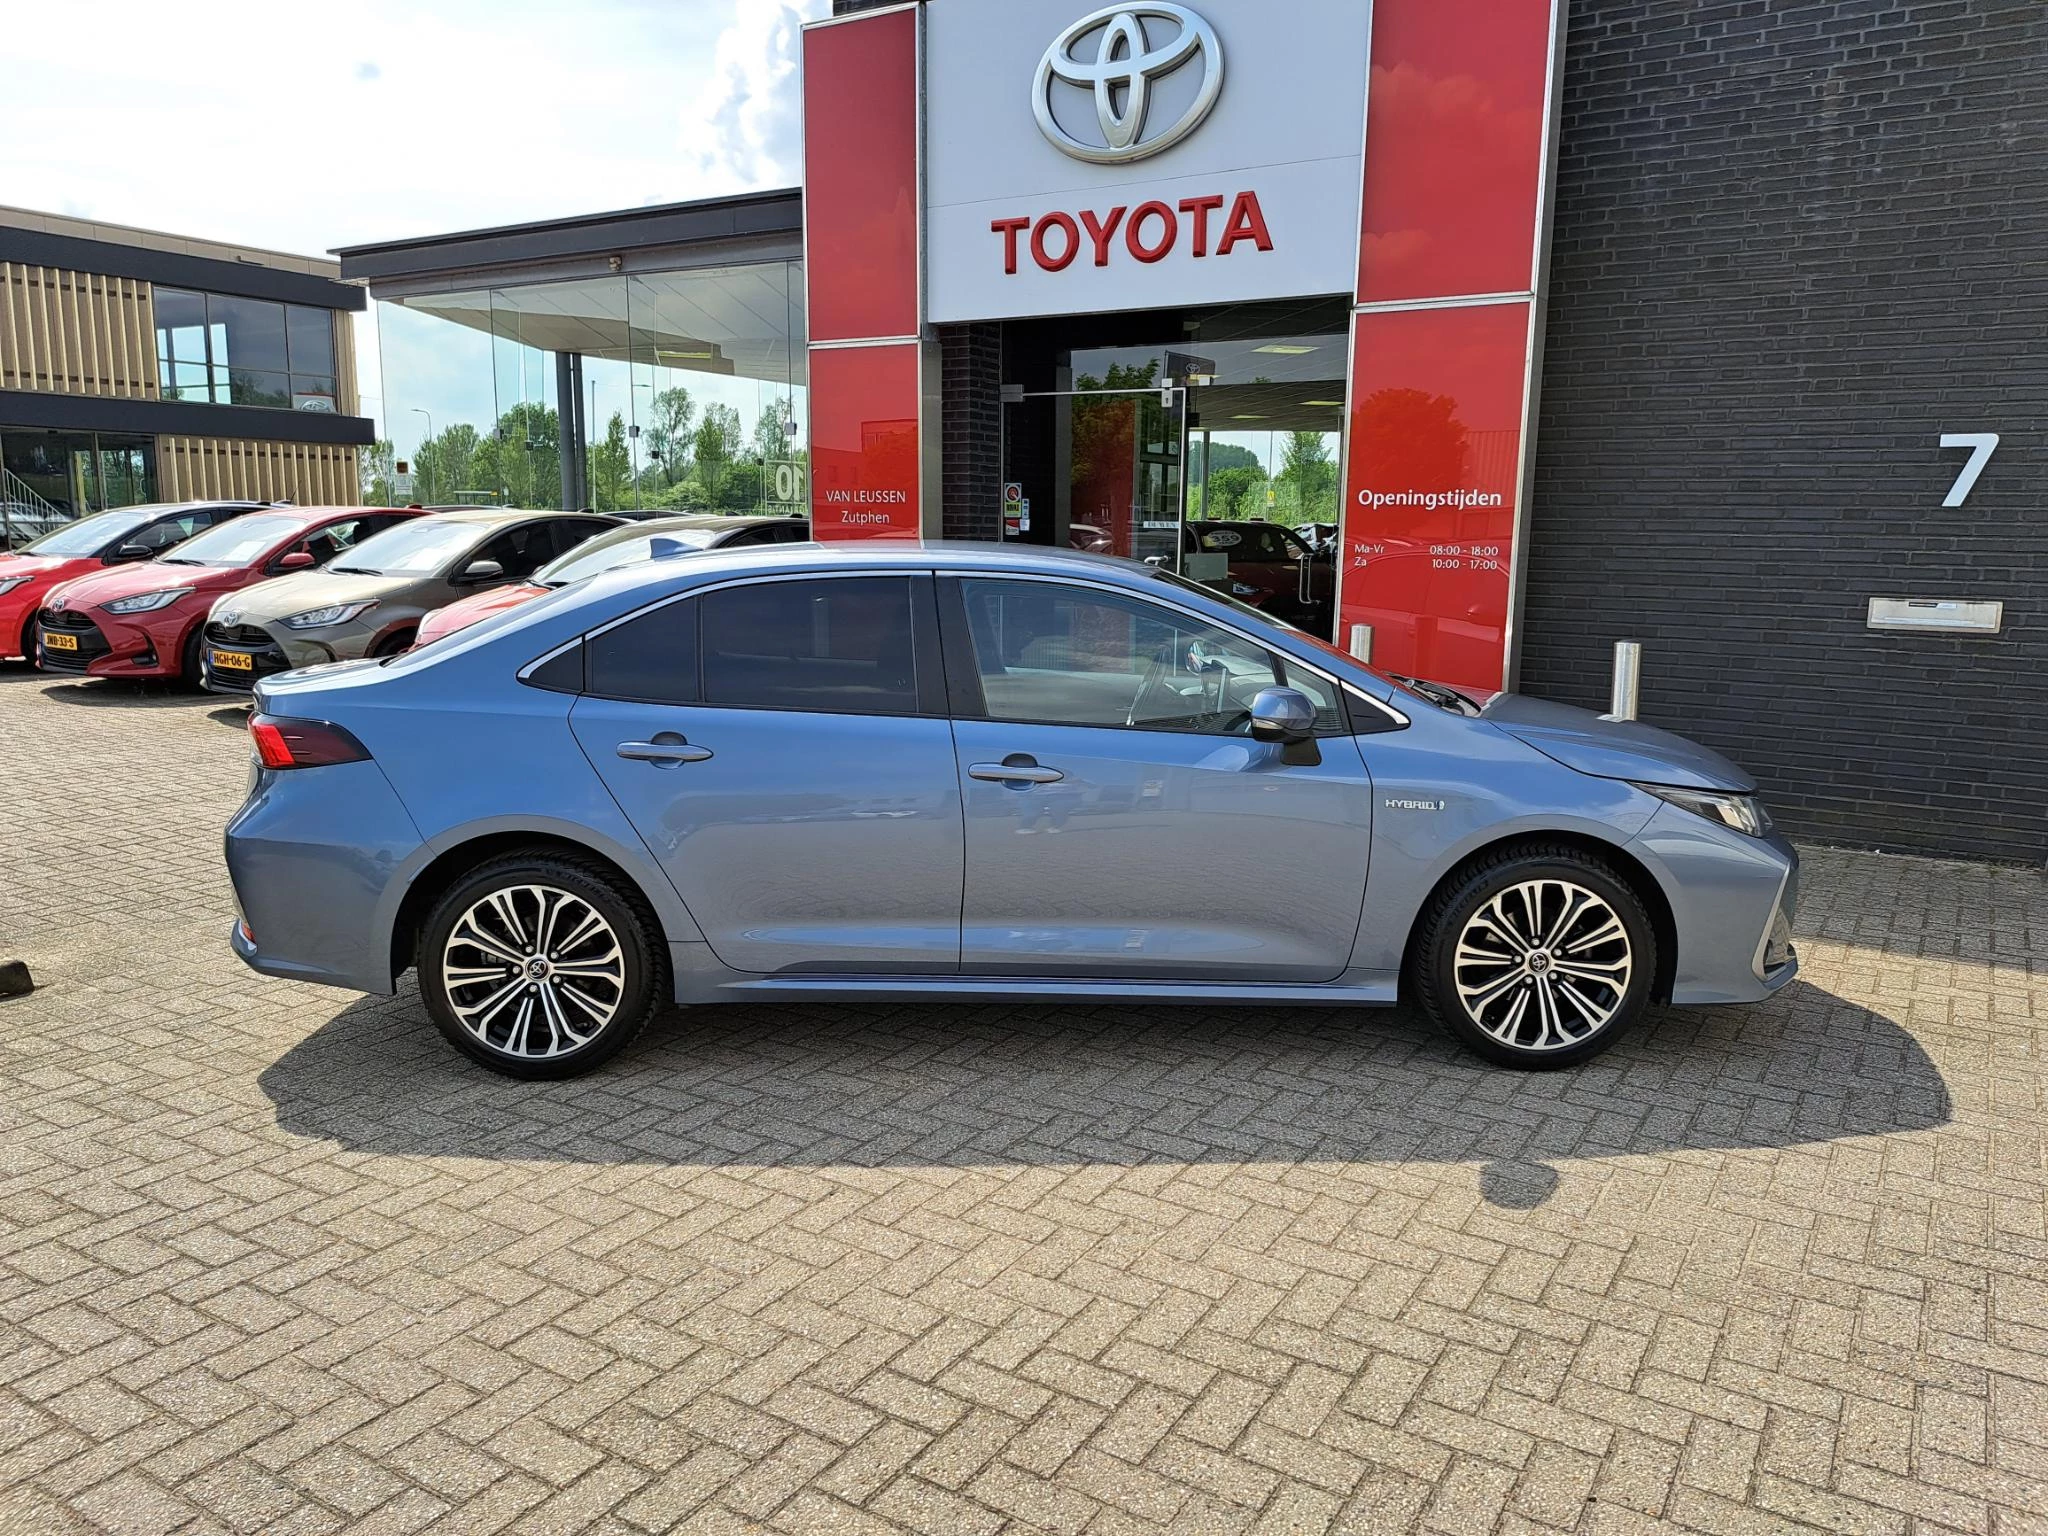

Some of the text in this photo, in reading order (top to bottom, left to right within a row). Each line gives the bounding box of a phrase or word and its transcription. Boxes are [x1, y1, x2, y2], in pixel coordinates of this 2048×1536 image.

[991, 190, 1274, 275] TOYOTA
[1939, 432, 2000, 507] 7
[826, 490, 906, 503] VAN LEUSSEN
[1358, 489, 1501, 510] Openingstijden
[841, 511, 890, 526] Zutphen
[1354, 544, 1384, 553] Ma-Vr
[1430, 545, 1460, 556] 08:00
[1471, 546, 1499, 557] 18:00
[1354, 557, 1367, 567] Za
[1432, 558, 1460, 569] 10:00
[1470, 559, 1498, 570] 17:00
[1385, 799, 1436, 810] HYBRID
